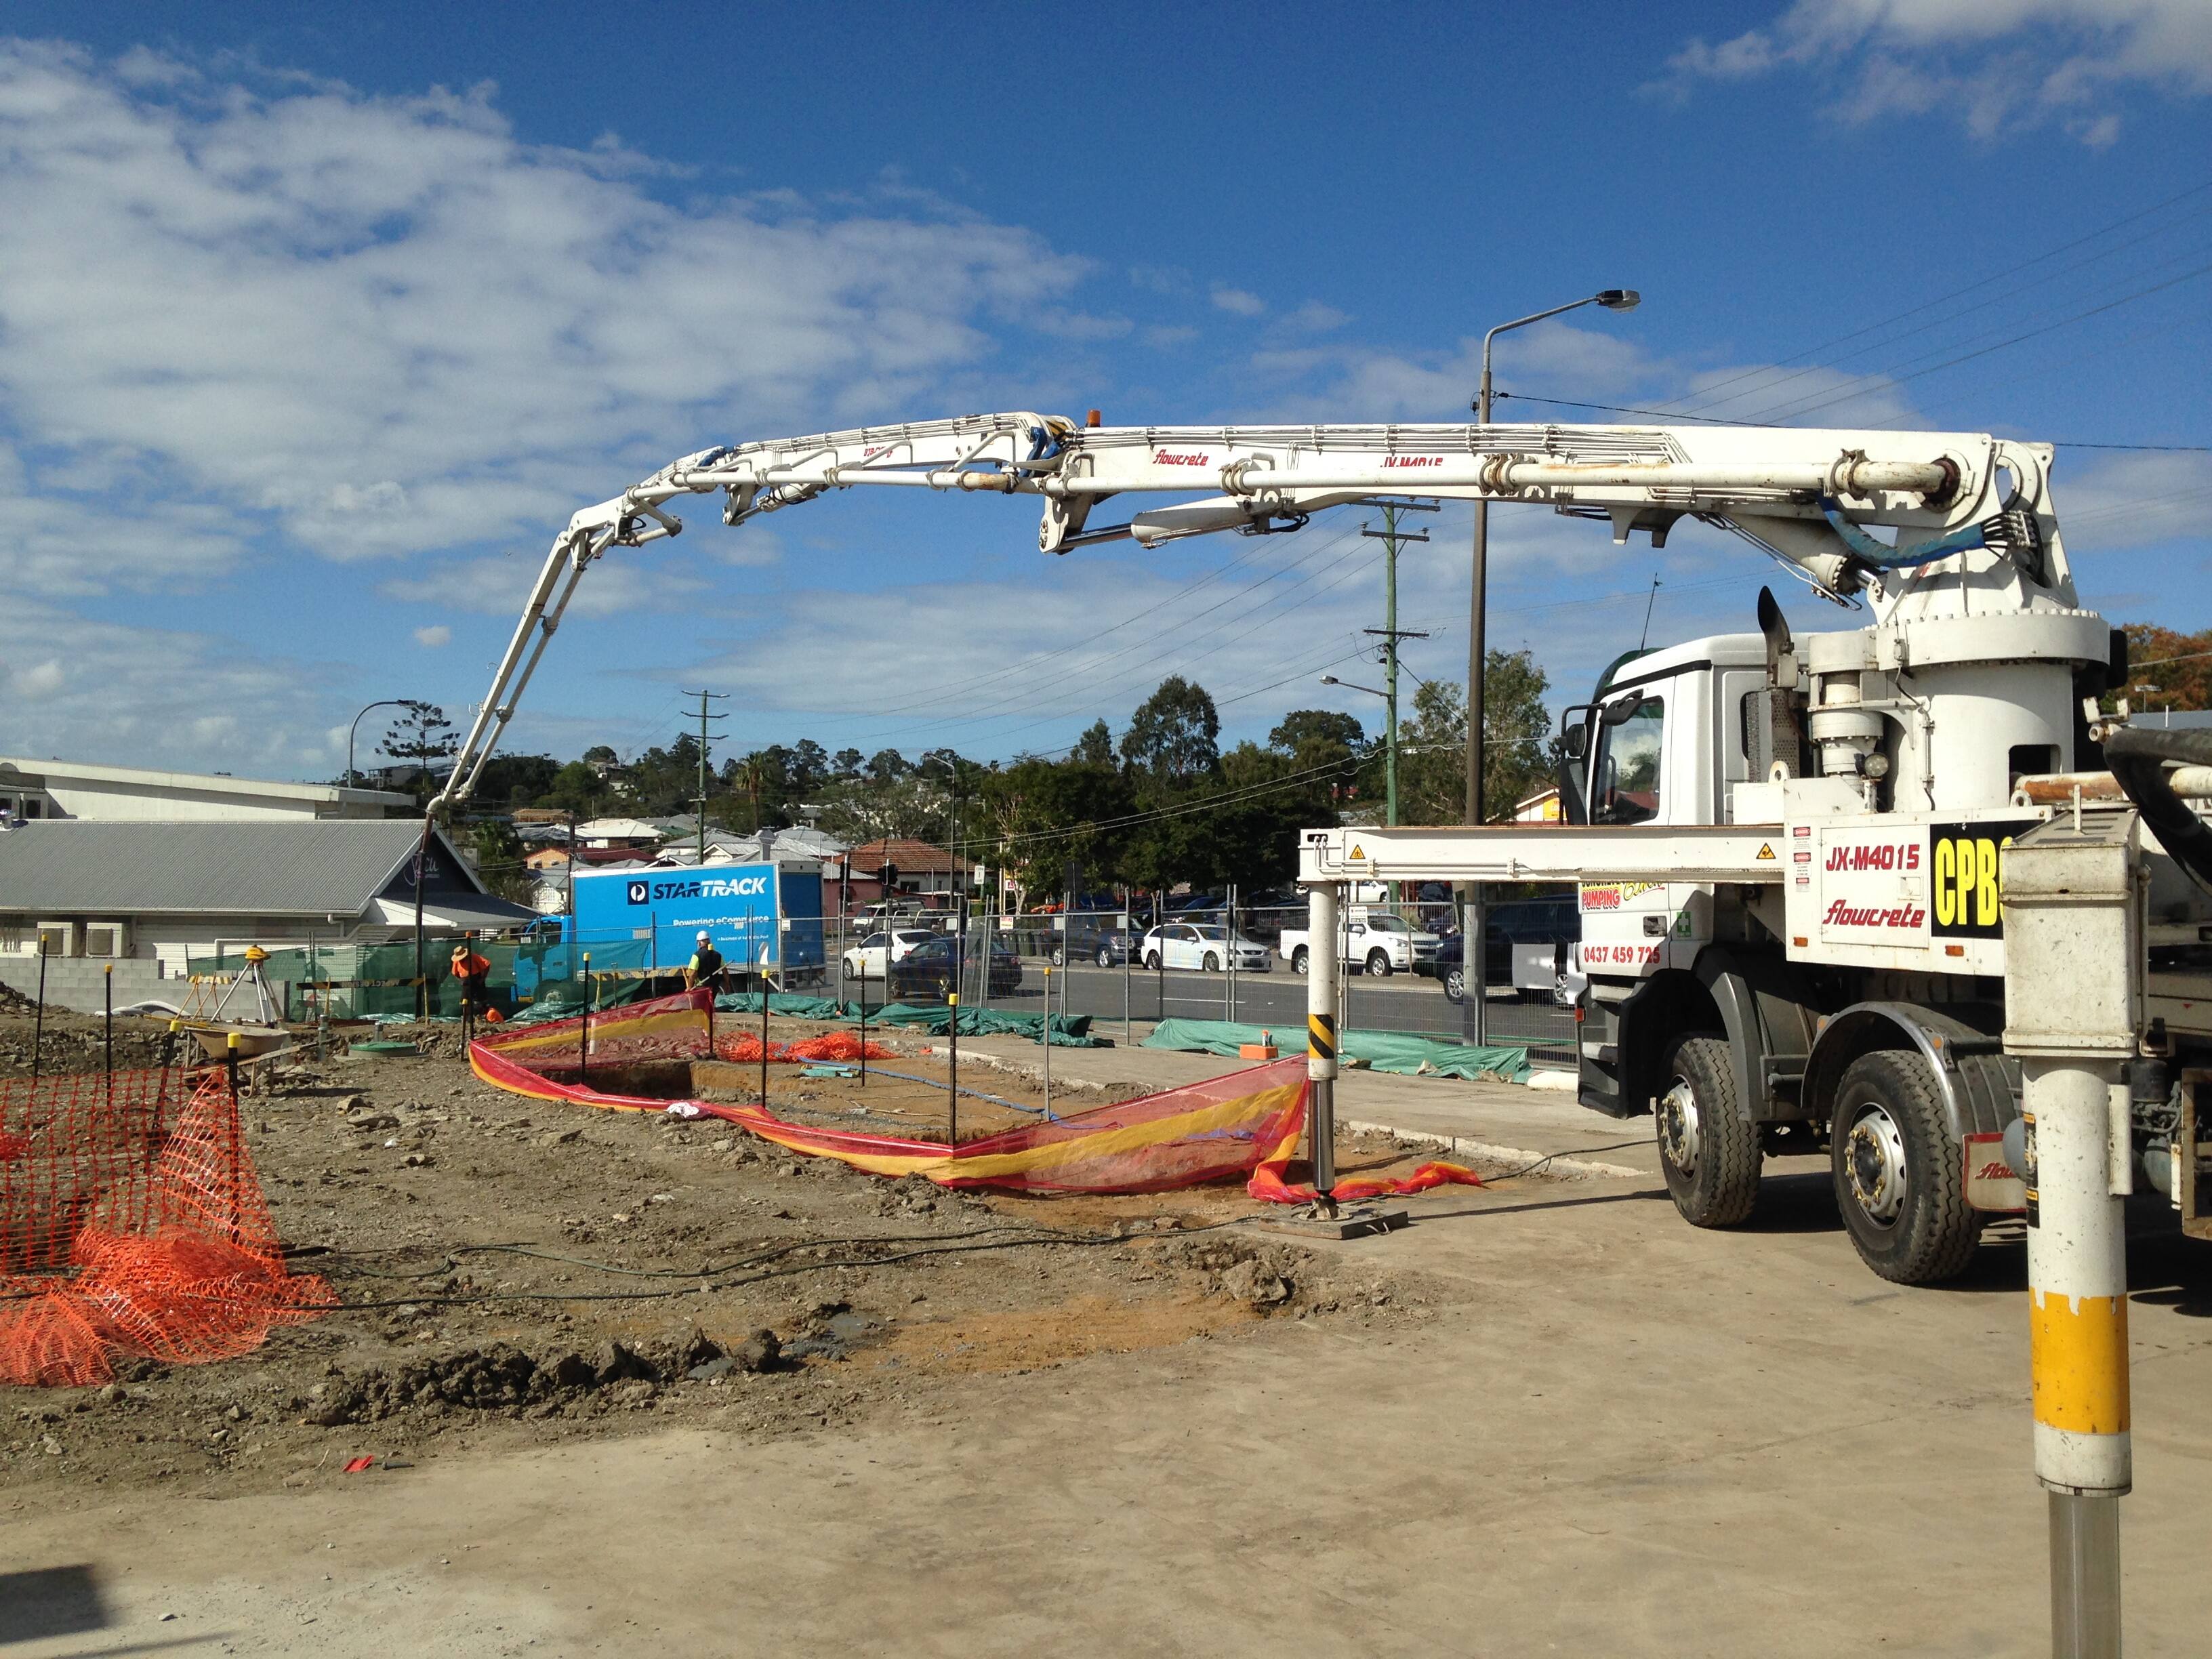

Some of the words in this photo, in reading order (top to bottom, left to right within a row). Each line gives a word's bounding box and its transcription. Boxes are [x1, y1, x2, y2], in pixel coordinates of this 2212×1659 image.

[1826, 844, 1920, 871] JX-M4015
[1935, 836, 2012, 926] CPB
[1582, 888, 1620, 909] PUMPING
[1822, 899, 1925, 928] flowcrete
[1584, 947, 1609, 963] 0437
[1612, 946, 1633, 963] 459
[1638, 946, 1660, 964] 725
